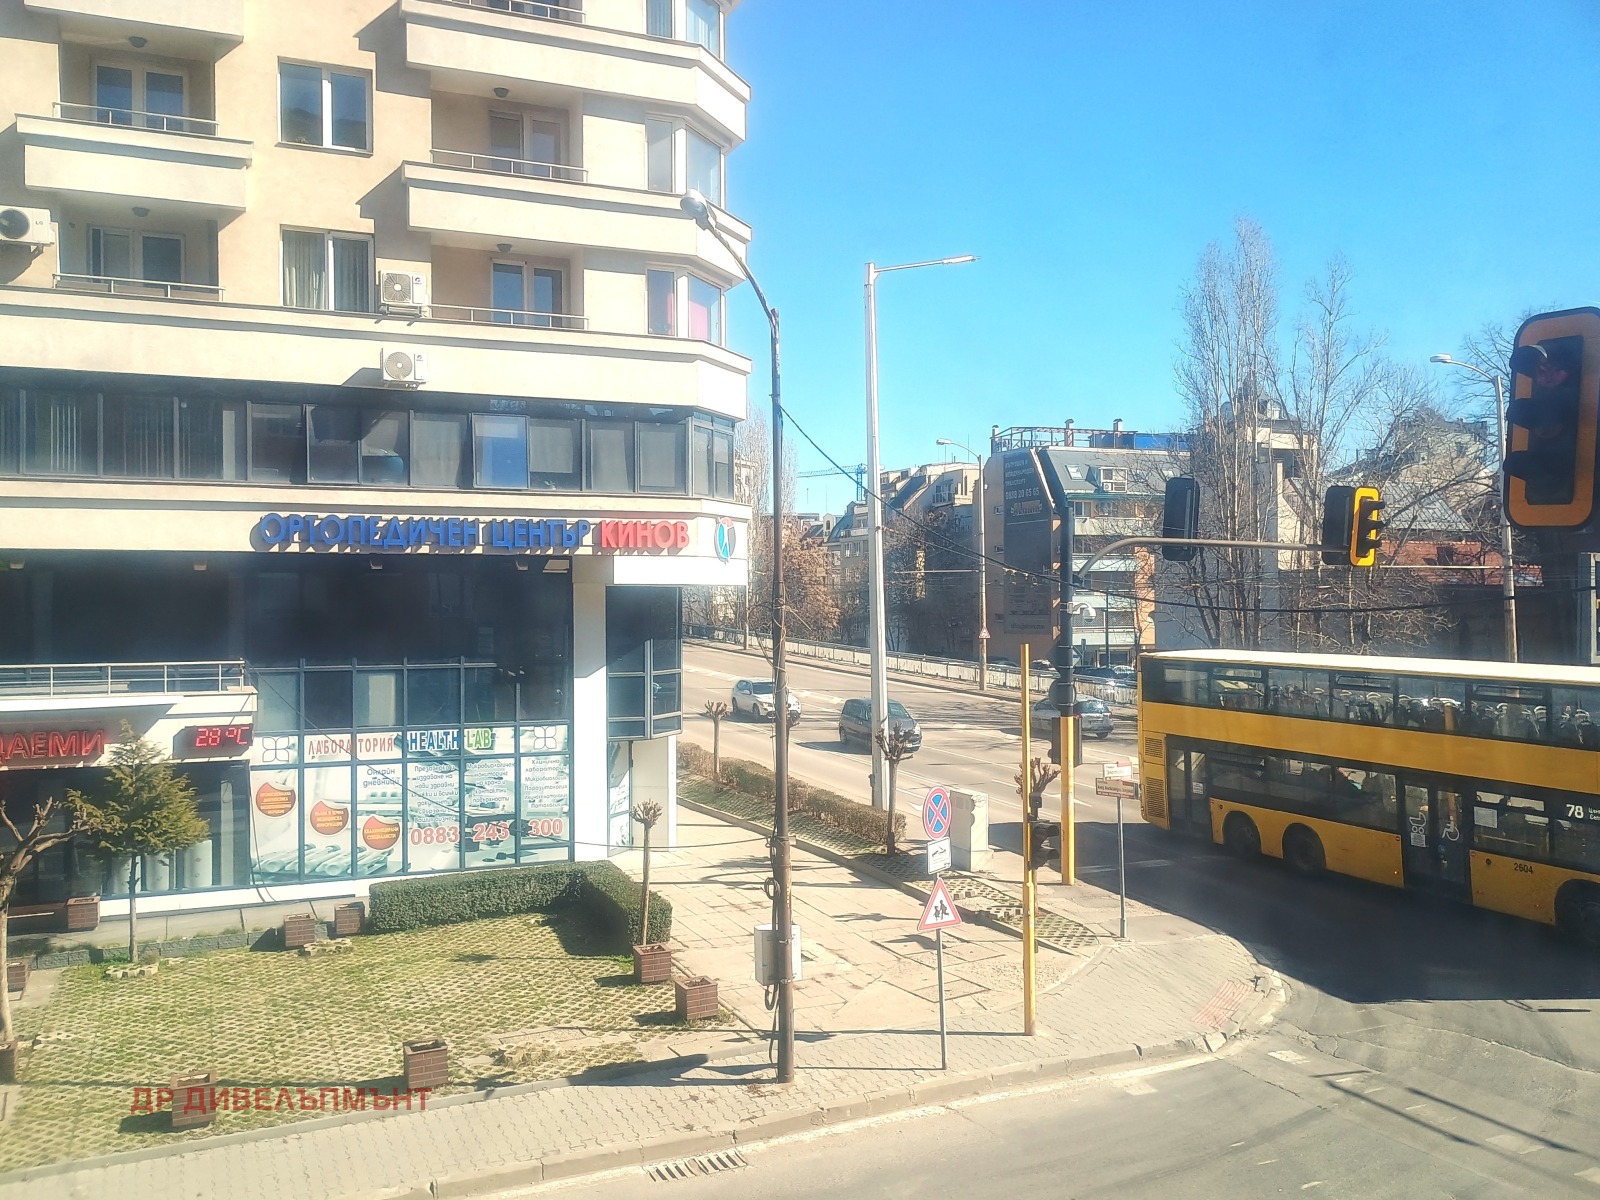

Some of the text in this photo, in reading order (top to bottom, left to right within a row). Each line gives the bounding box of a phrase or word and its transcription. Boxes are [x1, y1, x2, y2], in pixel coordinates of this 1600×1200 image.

[259, 513, 690, 551] ОРТОПЕДИЧЕН ЦЕНТЪР КИНОВ
[196, 727, 221, 747] 28
[408, 728, 493, 751] HEALTH LAB
[416, 774, 444, 782] издаване
[1566, 804, 1584, 818] 78
[410, 826, 459, 845] 0883
[529, 818, 563, 837] 300
